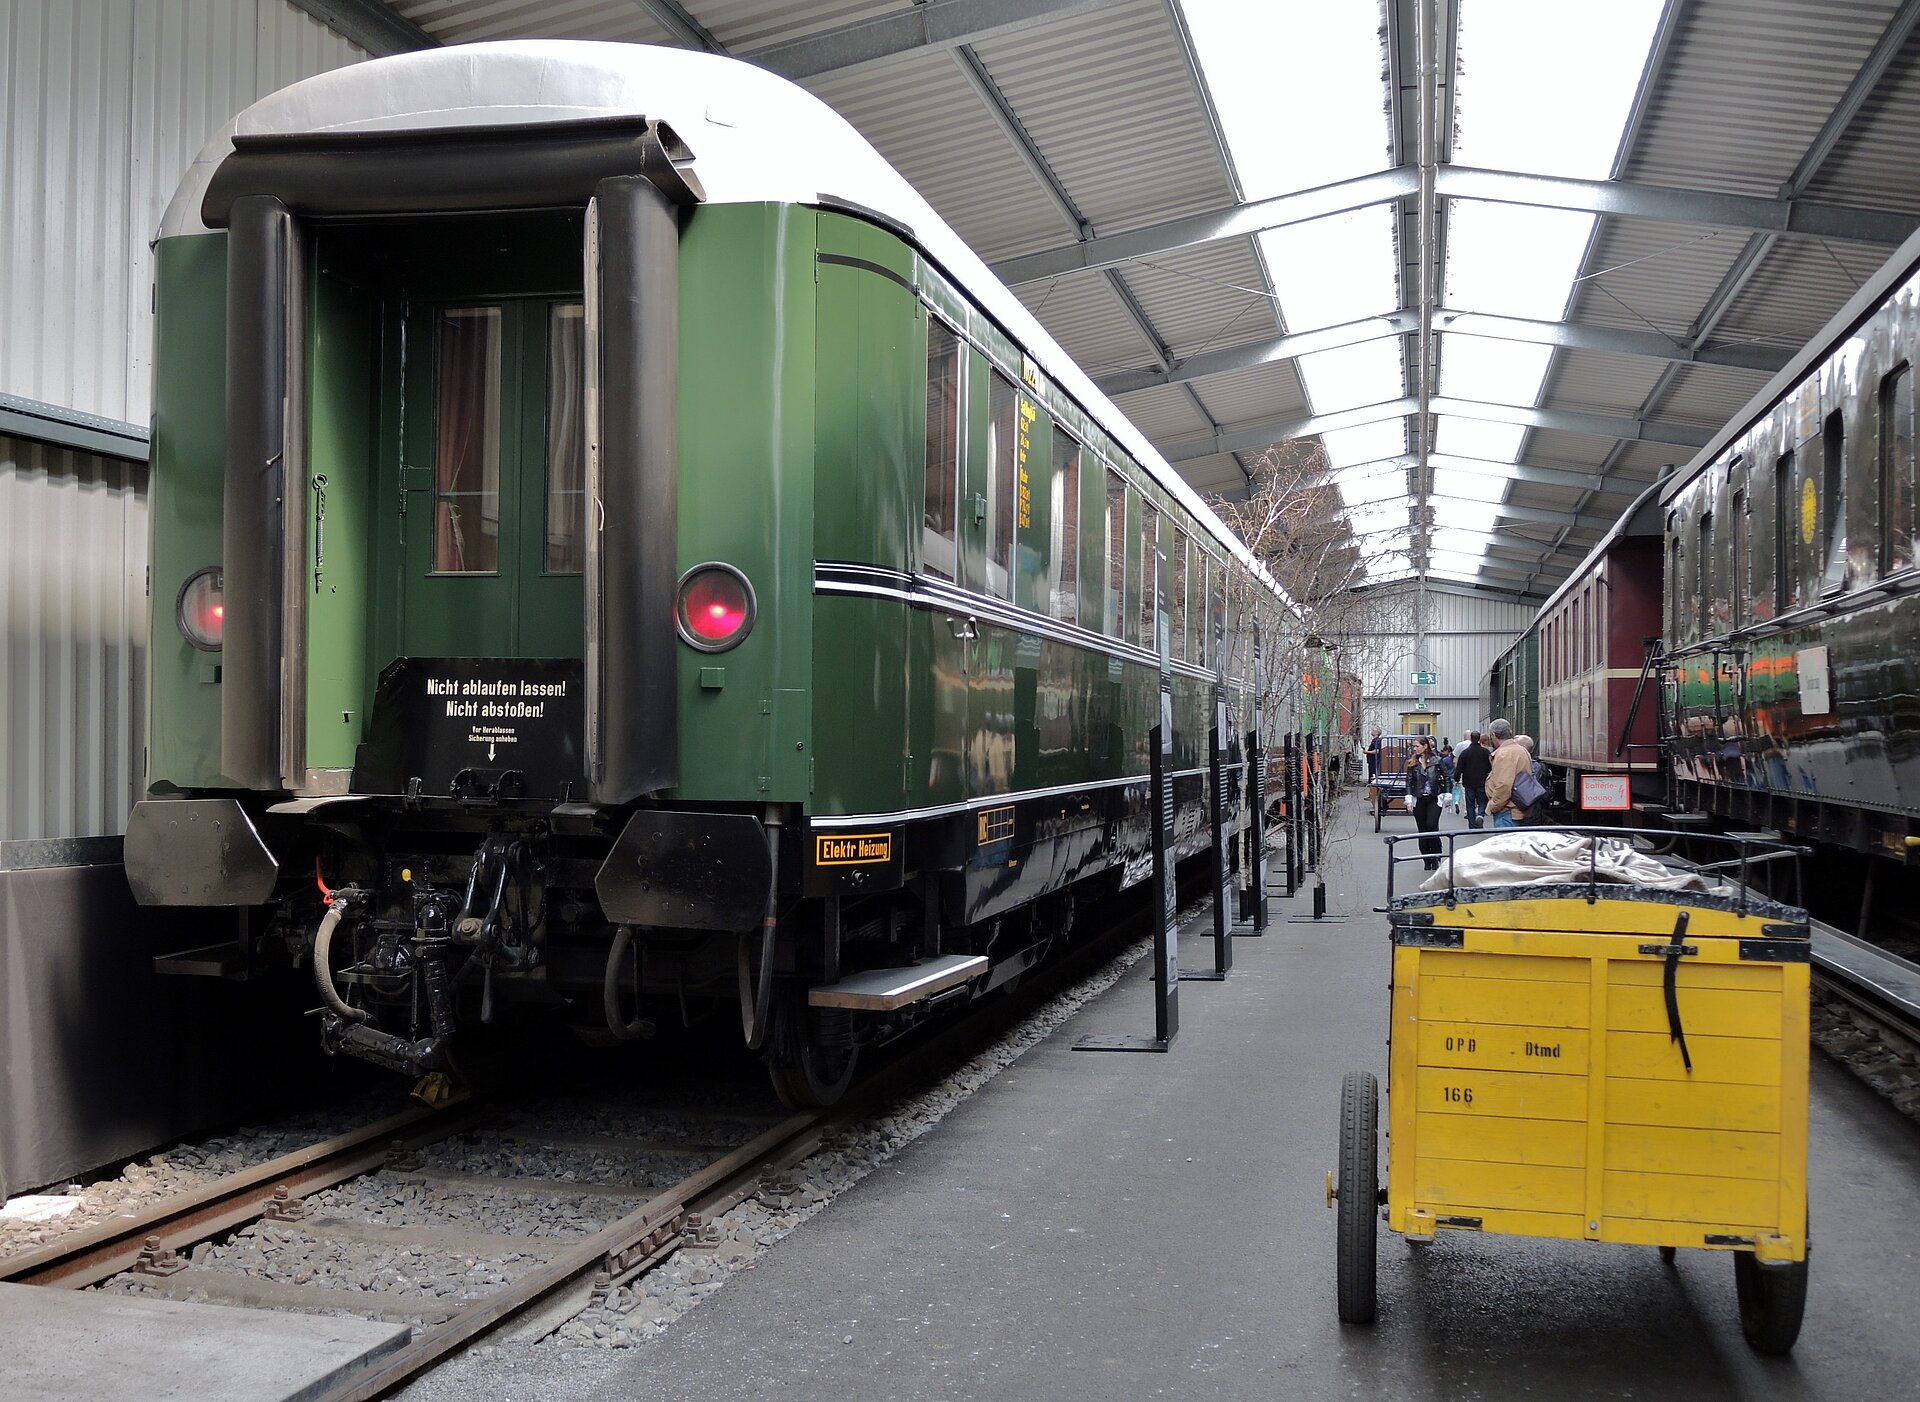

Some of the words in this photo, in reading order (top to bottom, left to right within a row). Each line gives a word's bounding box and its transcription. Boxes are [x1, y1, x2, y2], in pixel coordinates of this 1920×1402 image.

[427, 679, 459, 695] Nicht
[462, 680, 516, 696] ablaufen
[520, 680, 566, 697] lassen!
[446, 700, 478, 717] Nicht
[481, 701, 544, 718] abstoßen!
[468, 734, 495, 744] Sicherung
[495, 735, 518, 743] anheben
[823, 840, 857, 859] Elektr
[858, 839, 888, 859] Heizung
[1525, 1041, 1561, 1058] Dtmd
[1444, 1087, 1473, 1103] 166
